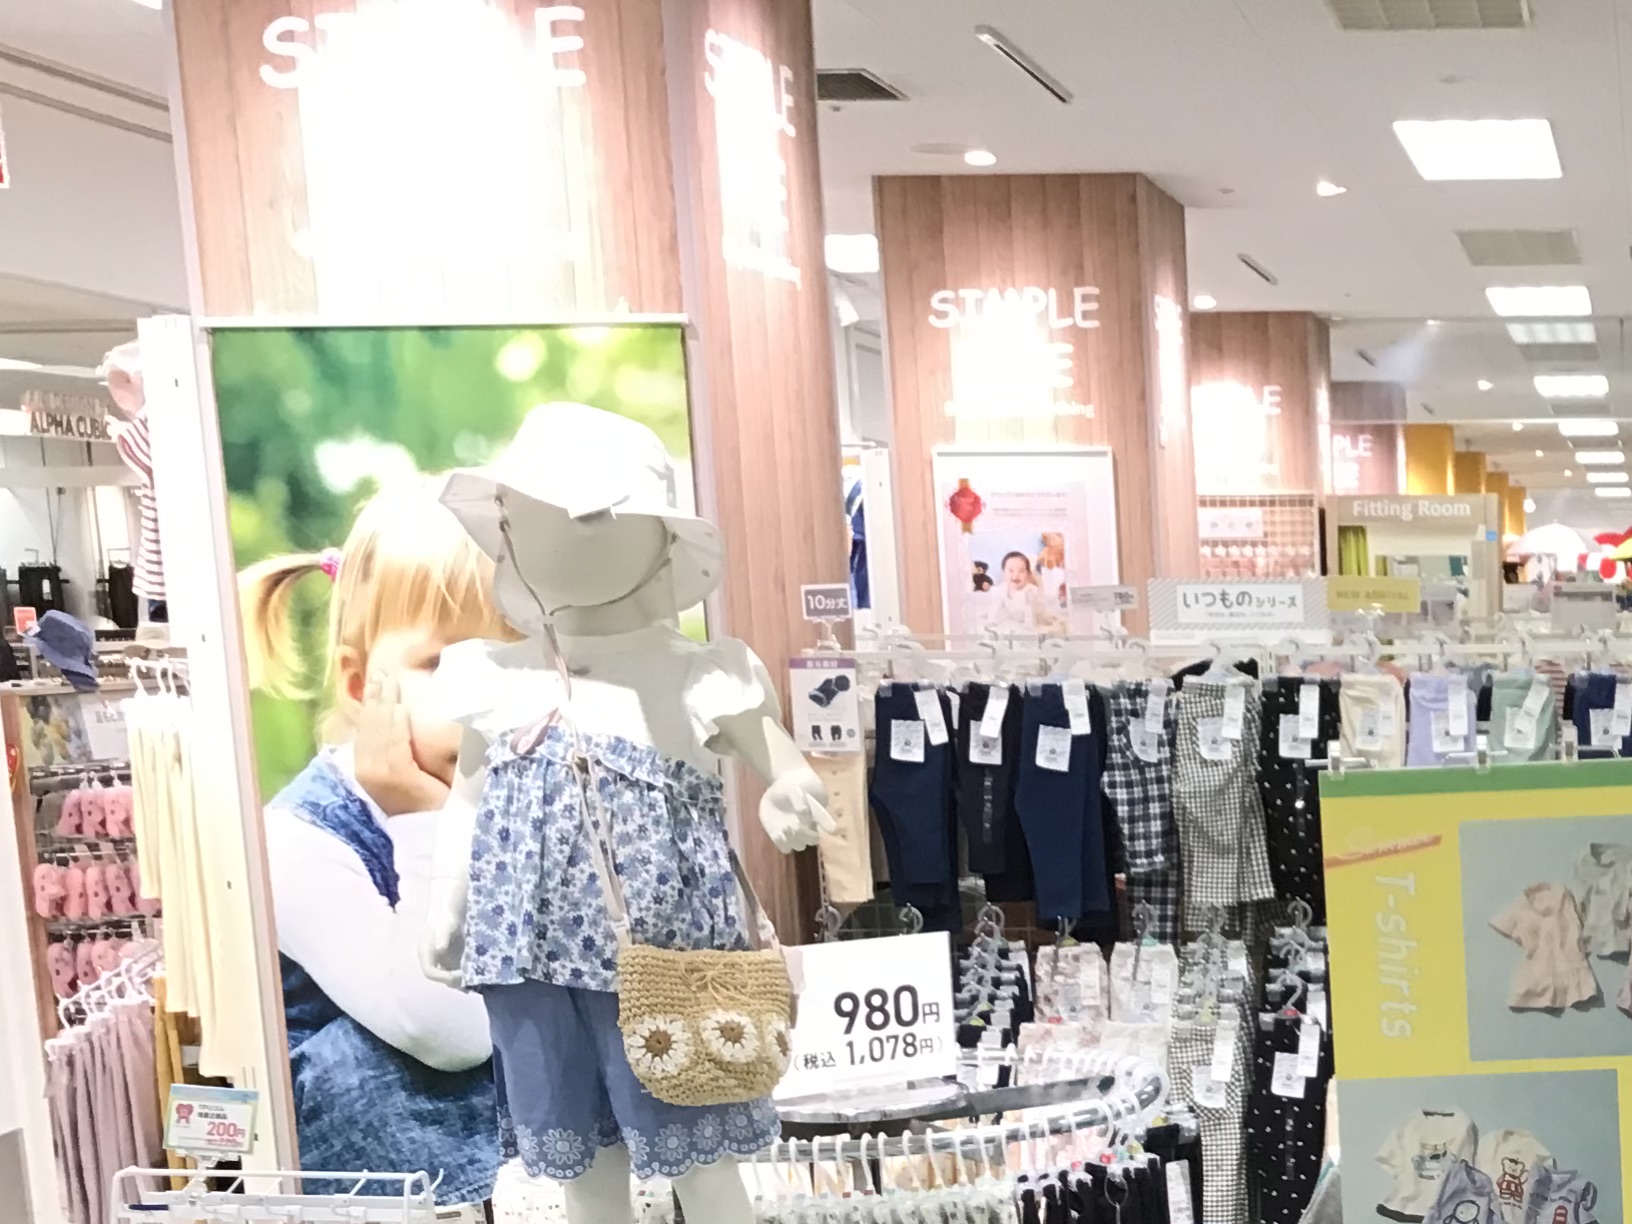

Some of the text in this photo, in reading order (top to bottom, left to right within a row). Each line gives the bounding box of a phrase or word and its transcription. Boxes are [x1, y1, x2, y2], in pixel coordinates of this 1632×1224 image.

[30, 411, 75, 437] ALPHA
[1352, 500, 1471, 520] Fitting Room
[1373, 871, 1420, 1041] T-shirts
[834, 983, 941, 1036] 980円
[206, 1122, 246, 1139] 200円
